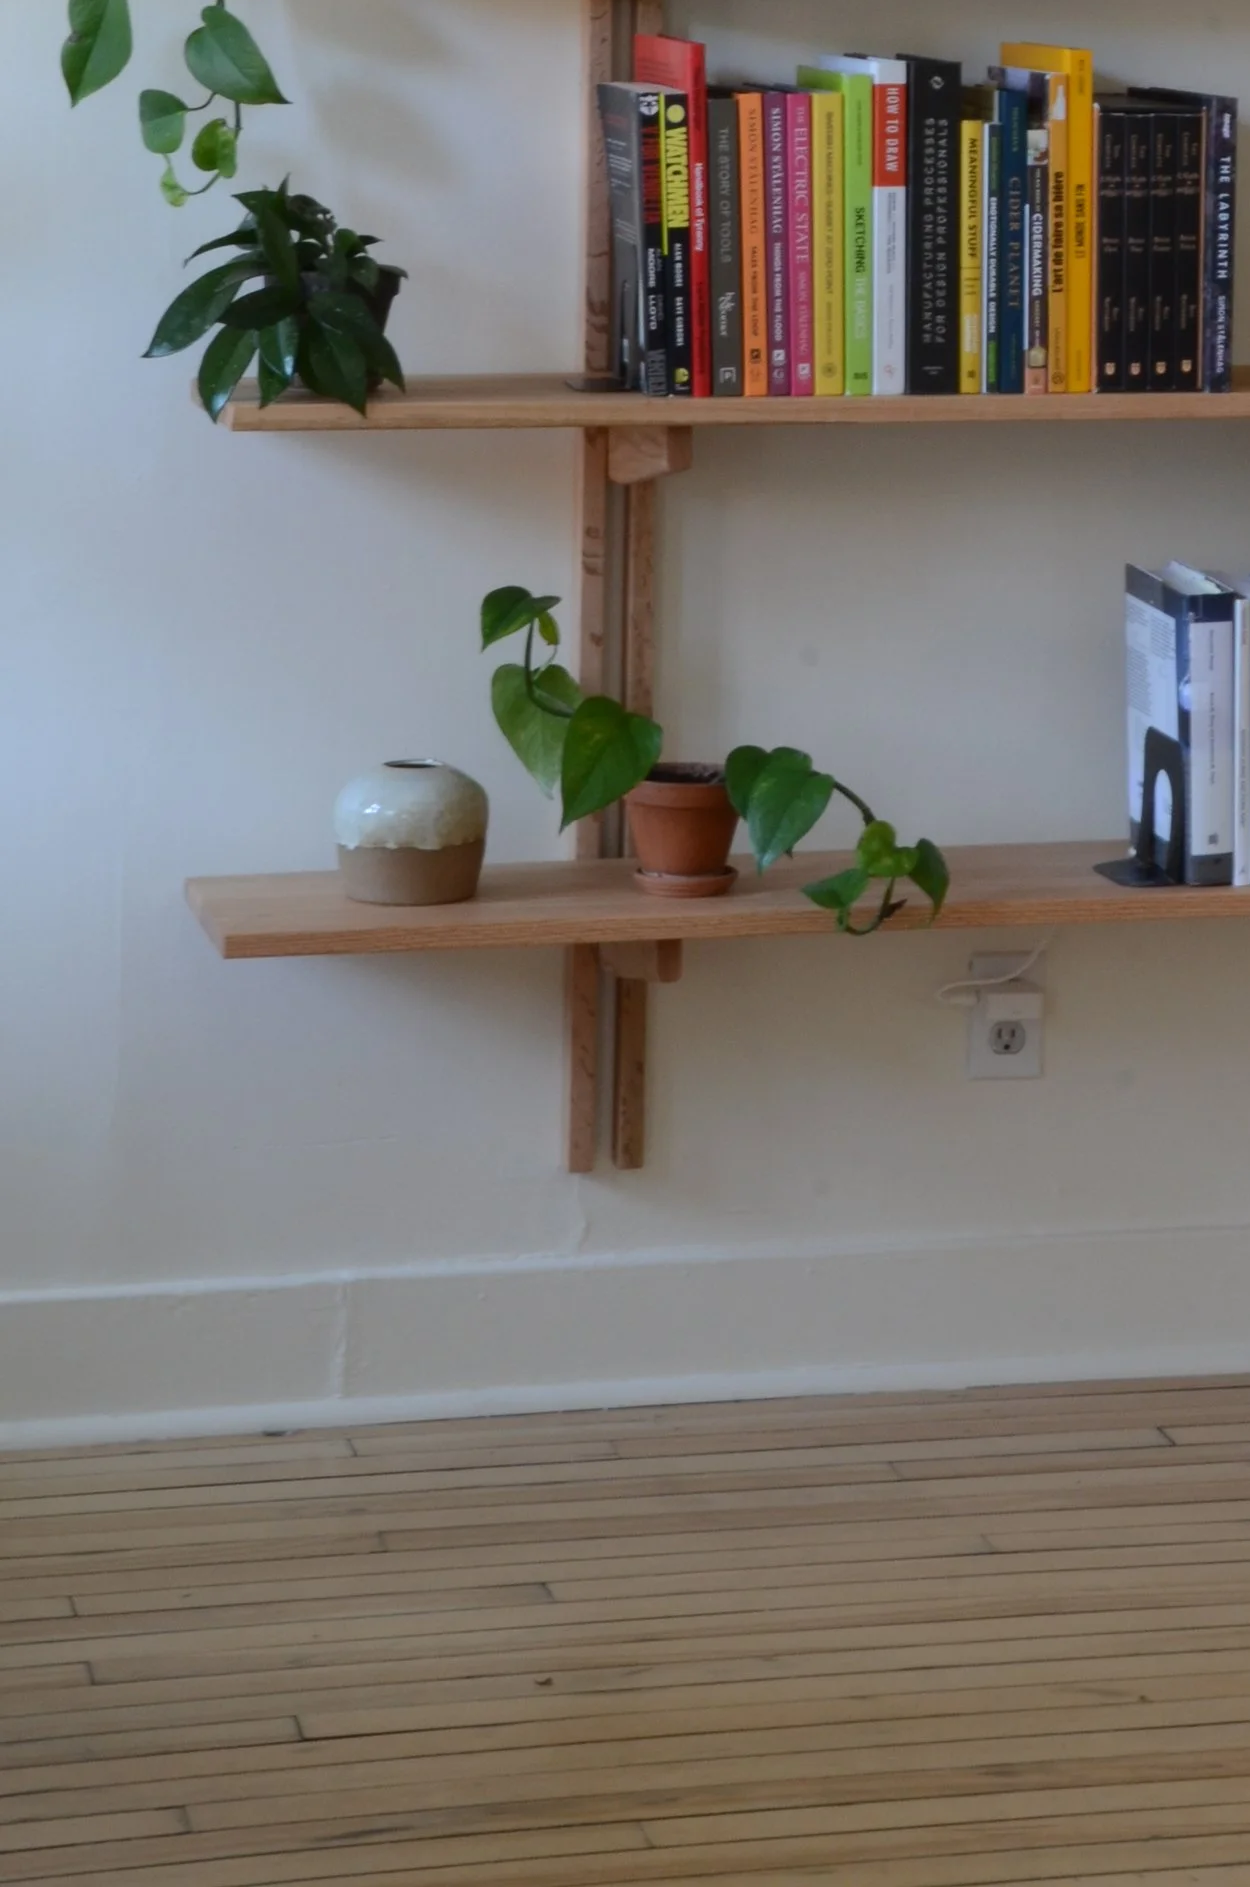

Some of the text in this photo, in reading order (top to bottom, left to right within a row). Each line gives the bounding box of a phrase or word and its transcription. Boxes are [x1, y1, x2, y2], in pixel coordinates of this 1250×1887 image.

[748, 108, 758, 153] SIMON
[794, 127, 809, 207] ELECTRIC
[885, 87, 900, 172] HOW TO DRAW
[665, 126, 690, 228] WATCHMEN
[693, 162, 705, 252] Handbook of Tyranny
[717, 127, 732, 263] THE STORY OF TOOLS
[967, 137, 978, 260] MEANINGFUL STUFF
[673, 243, 684, 288] ALAN MOORE
[770, 107, 784, 342] SIMON STÅLENHAG THINGS FROM THE FLOOD
[794, 212, 809, 264] STATE
[854, 206, 866, 273] SKETCHING
[921, 117, 937, 344] MANUFACTURING PROCESSES
[935, 118, 949, 344] FOR DESIGN PROFESSIONALS
[988, 196, 998, 257] EMOTIONALLY
[1007, 176, 1022, 310] CIDER PLANET
[1031, 212, 1043, 296] CIDERMAKING
[1052, 171, 1065, 293] L'art de faire sa bière
[1215, 155, 1232, 374] THE LABYRINTH SIMON STÅLENHAG
[647, 248, 657, 288] MOORE
[674, 296, 684, 314] DAVE
[854, 277, 867, 296] THE
[988, 258, 997, 298] DURABLE
[648, 294, 658, 330] LLOYD
[988, 301, 997, 333] DESIGN
